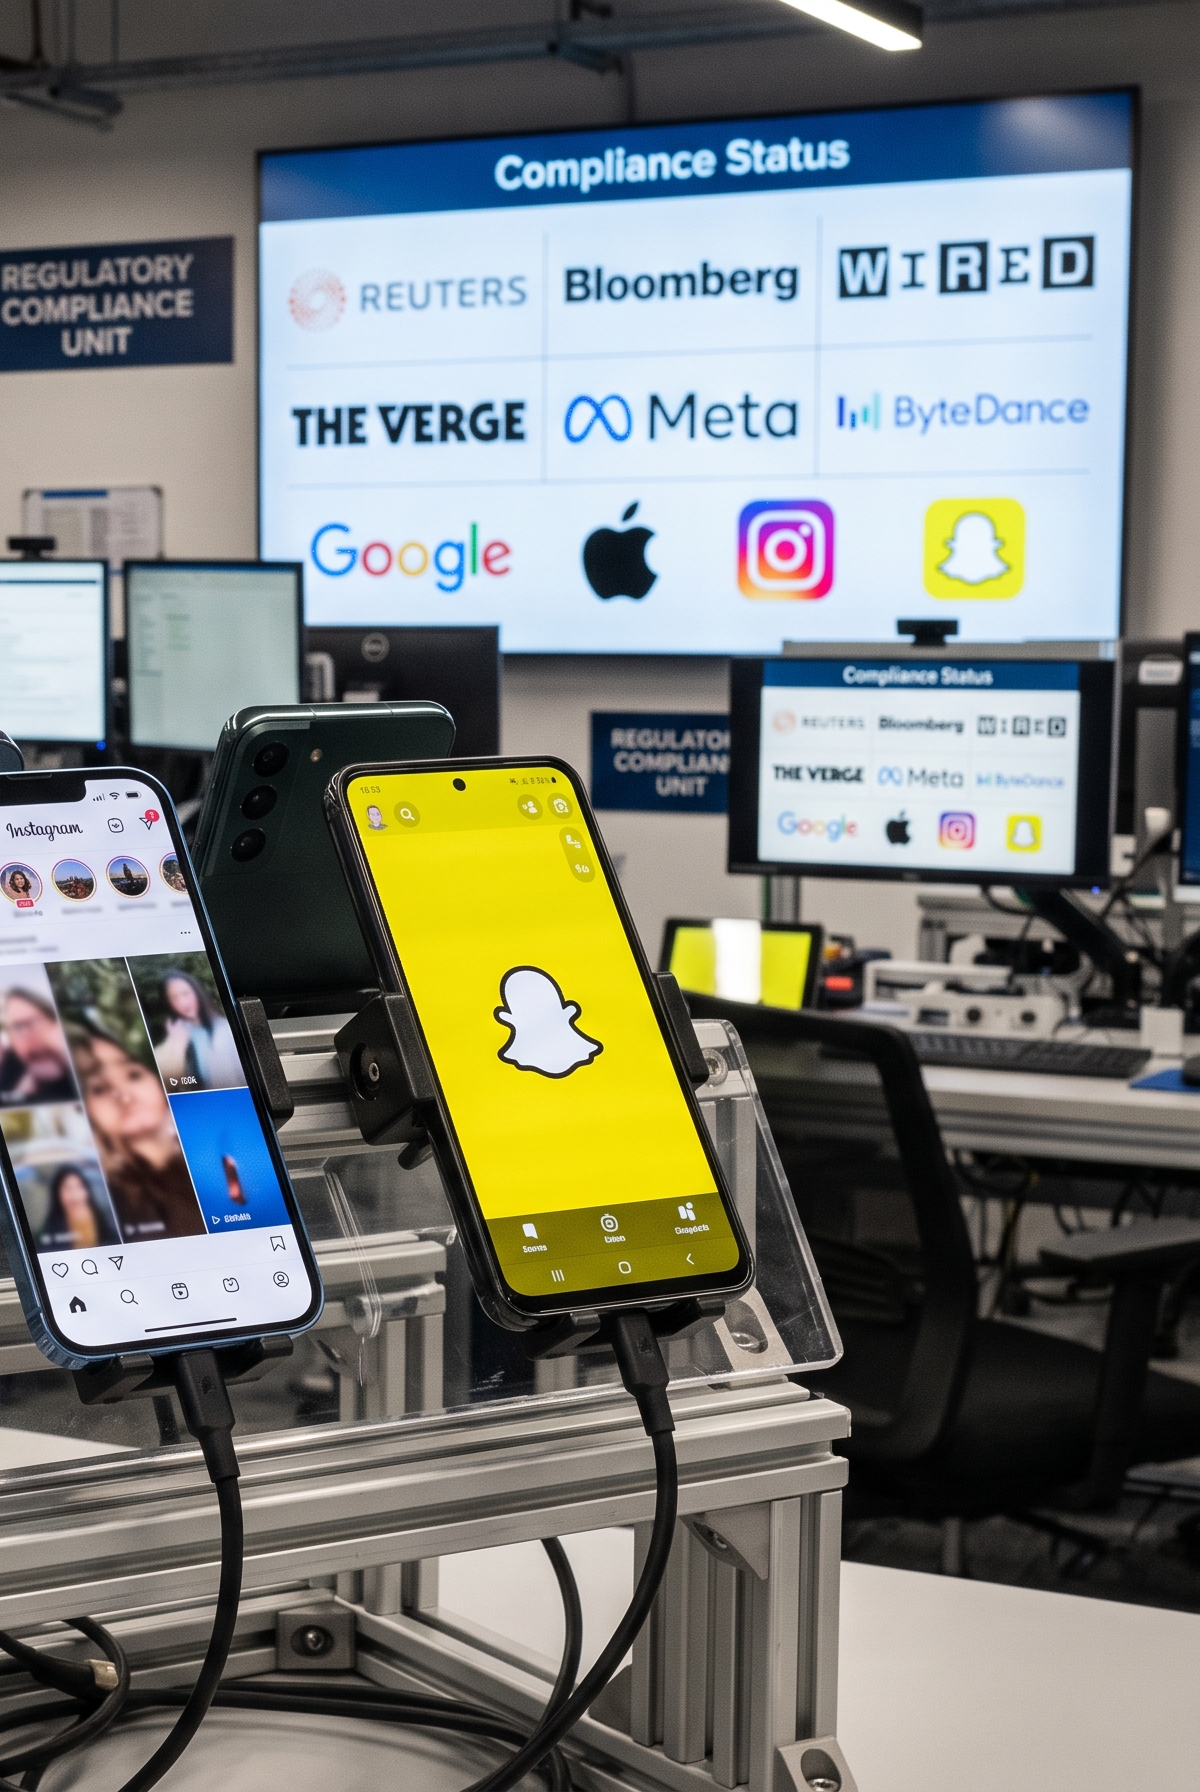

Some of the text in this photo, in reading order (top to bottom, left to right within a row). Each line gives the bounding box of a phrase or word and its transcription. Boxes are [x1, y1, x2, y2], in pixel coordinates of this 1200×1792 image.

[494, 136, 850, 193] Compliance Status
[1, 253, 194, 291] REGULATORY
[565, 262, 800, 302] Bloomberg
[838, 235, 1096, 300] WIRED
[1, 289, 194, 326] COMPLIANCE
[359, 275, 528, 313] REUTERS
[61, 326, 132, 357] UNIT
[293, 401, 526, 446] THE VERGE
[648, 393, 798, 441] Meta
[894, 393, 1091, 435] ByteDance
[311, 522, 512, 593] Google
[842, 665, 994, 687] Compliance Status
[801, 717, 865, 729] REUTERS
[878, 716, 964, 735] Bloomberg
[655, 775, 709, 797] UNIT
[773, 765, 864, 784] THE VERGE
[906, 769, 965, 789] Meta
[6, 821, 83, 842] Instagram
[777, 810, 857, 843] Google
